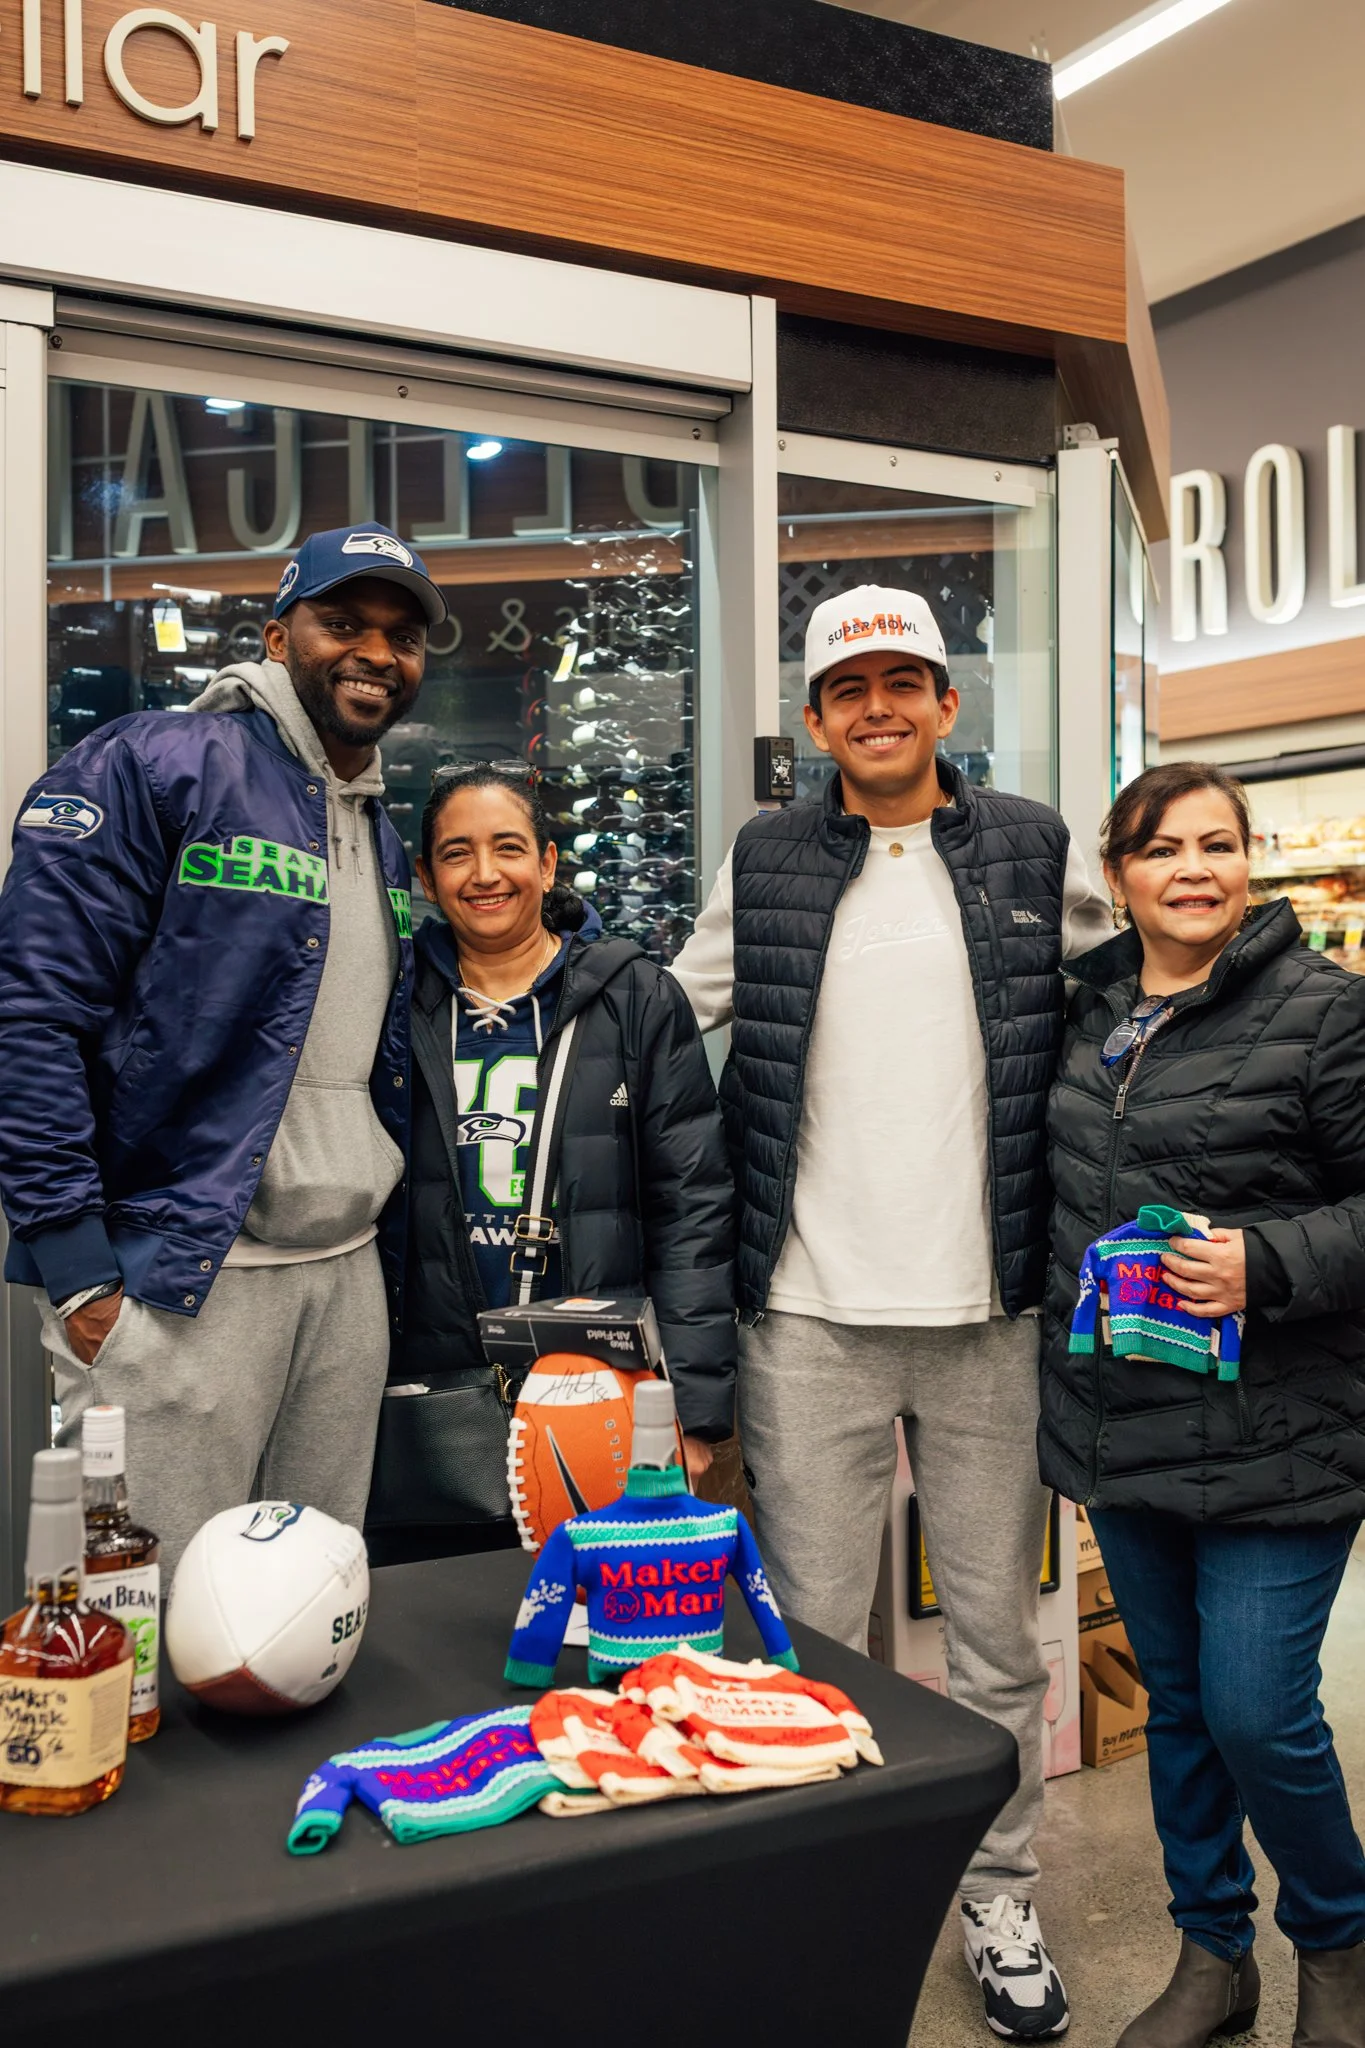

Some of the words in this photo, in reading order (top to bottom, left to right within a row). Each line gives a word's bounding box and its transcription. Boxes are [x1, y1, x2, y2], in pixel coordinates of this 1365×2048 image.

[827, 621, 870, 646] SUPER
[878, 619, 920, 635] BOWL
[116, 1585, 156, 1611] BEAM
